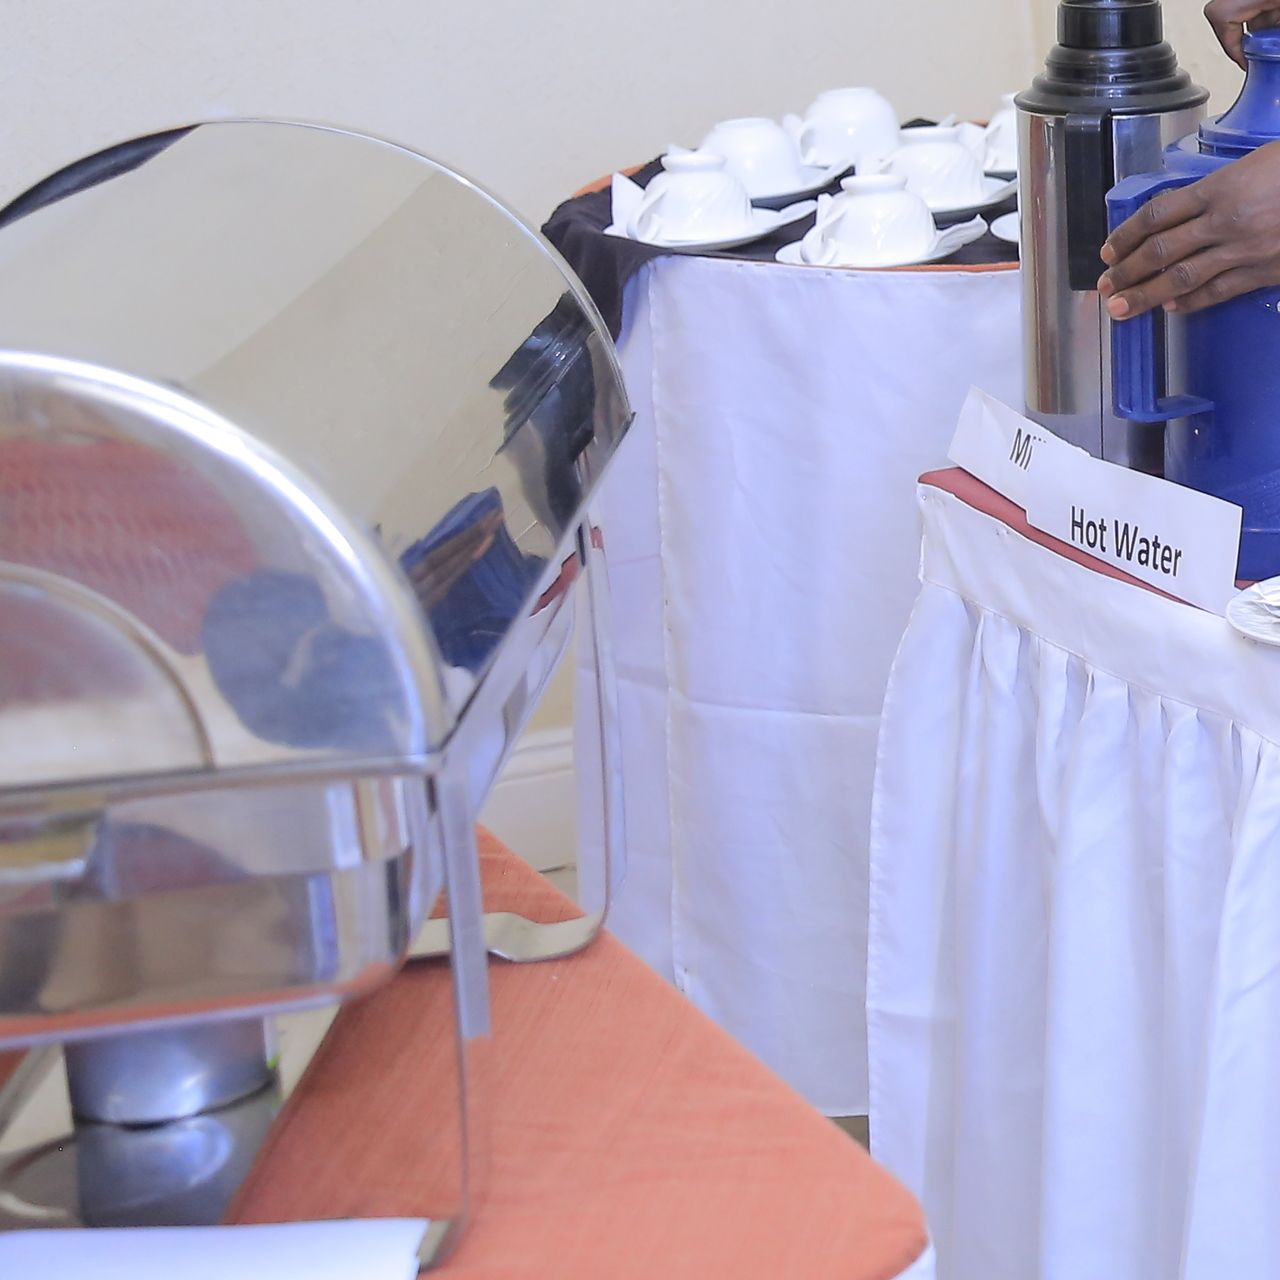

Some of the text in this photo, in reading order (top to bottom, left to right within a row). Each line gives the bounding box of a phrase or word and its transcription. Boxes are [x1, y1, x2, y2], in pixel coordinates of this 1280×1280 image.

[1009, 427, 1047, 471] Mi
[1071, 505, 1183, 577] Hot Water
